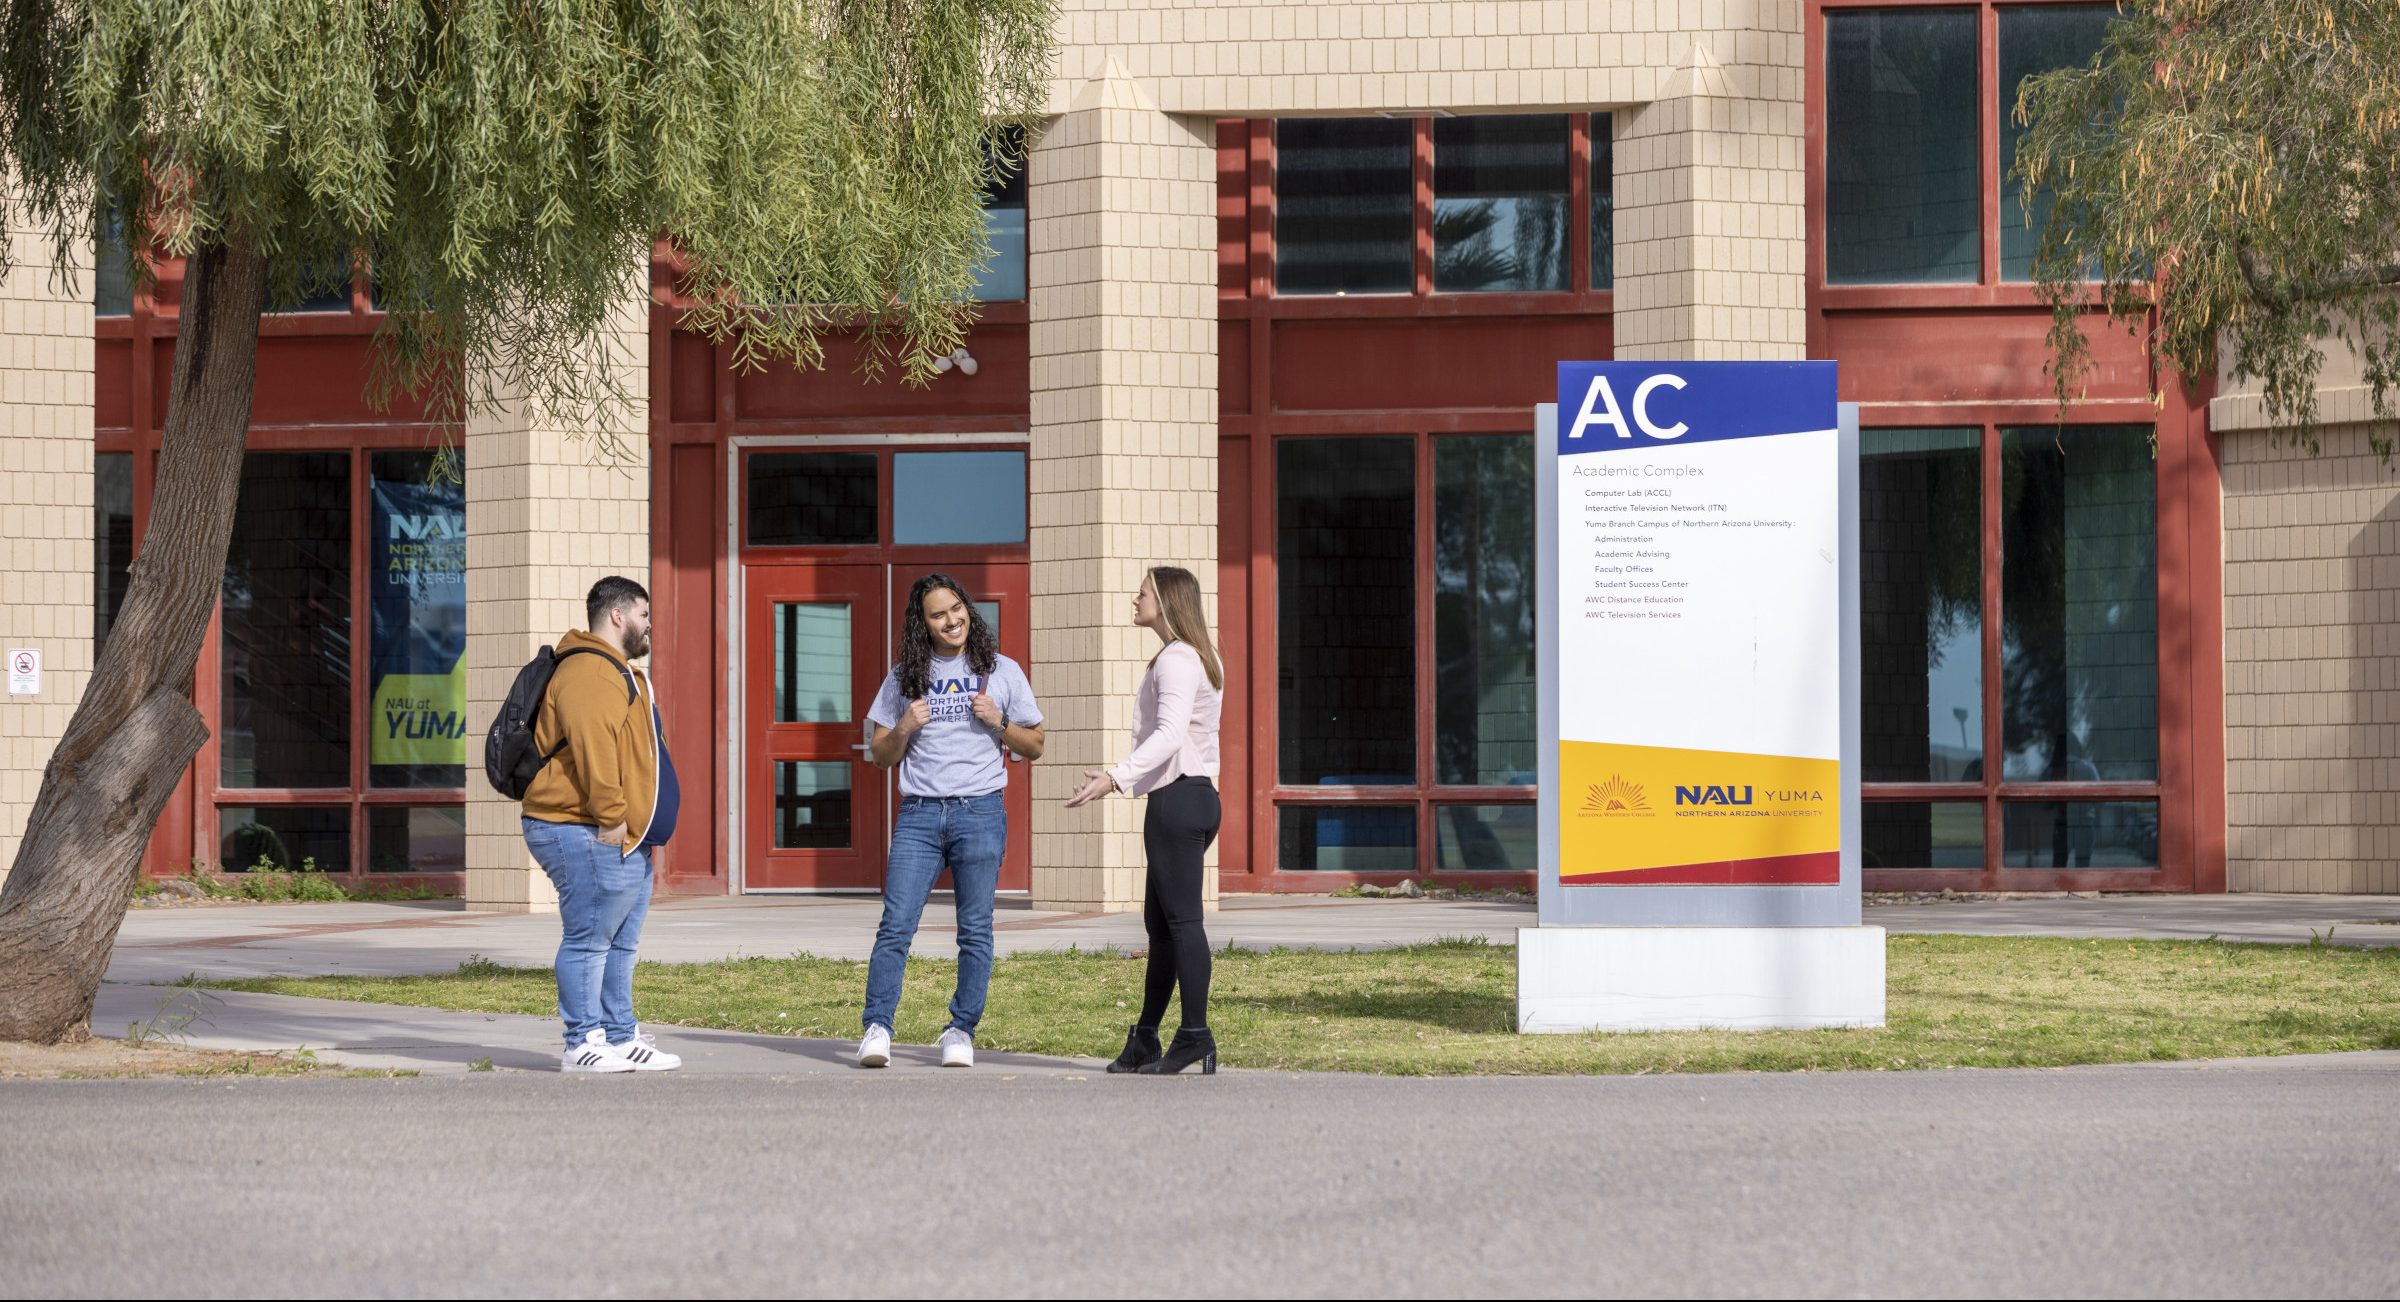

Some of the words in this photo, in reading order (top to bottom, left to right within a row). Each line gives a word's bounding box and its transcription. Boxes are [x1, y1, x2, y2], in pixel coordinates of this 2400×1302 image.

[1568, 373, 1689, 439] AC
[1572, 464, 1640, 477] Academic
[1643, 464, 1705, 480] Complex
[1584, 489, 1626, 499] Computer
[1627, 489, 1642, 498] Lab
[1644, 489, 1672, 498] (ACCL)
[1584, 504, 1628, 513] Interactive
[1629, 504, 1669, 513] Television
[1670, 504, 1706, 513] Network
[1707, 504, 1728, 513] (ITN)
[1585, 520, 1607, 528] Yuma
[1608, 520, 1636, 528] Branch
[1637, 520, 1670, 530] Campus
[1671, 520, 1681, 528] of
[1682, 520, 1720, 528] Northern
[1721, 520, 1752, 528] Arizona
[1594, 535, 1654, 544] Administration
[1594, 550, 1634, 559] Academic
[1635, 550, 1671, 560] Advising
[1594, 565, 1624, 575] Faculty
[1625, 565, 1654, 574] Offices
[1594, 580, 1627, 589] Student
[1628, 580, 1660, 589] Success
[1661, 580, 1689, 589] Center
[1584, 595, 1606, 604] AWC
[1607, 595, 1642, 604] Distance
[1643, 595, 1684, 604] Education
[1584, 610, 1606, 619] AWC
[1607, 610, 1647, 619] Television
[1648, 610, 1682, 619] Services
[386, 698, 415, 709] NAU
[417, 699, 431, 709] at
[1674, 785, 1753, 805] NAU
[1764, 790, 1824, 802] YUMA
